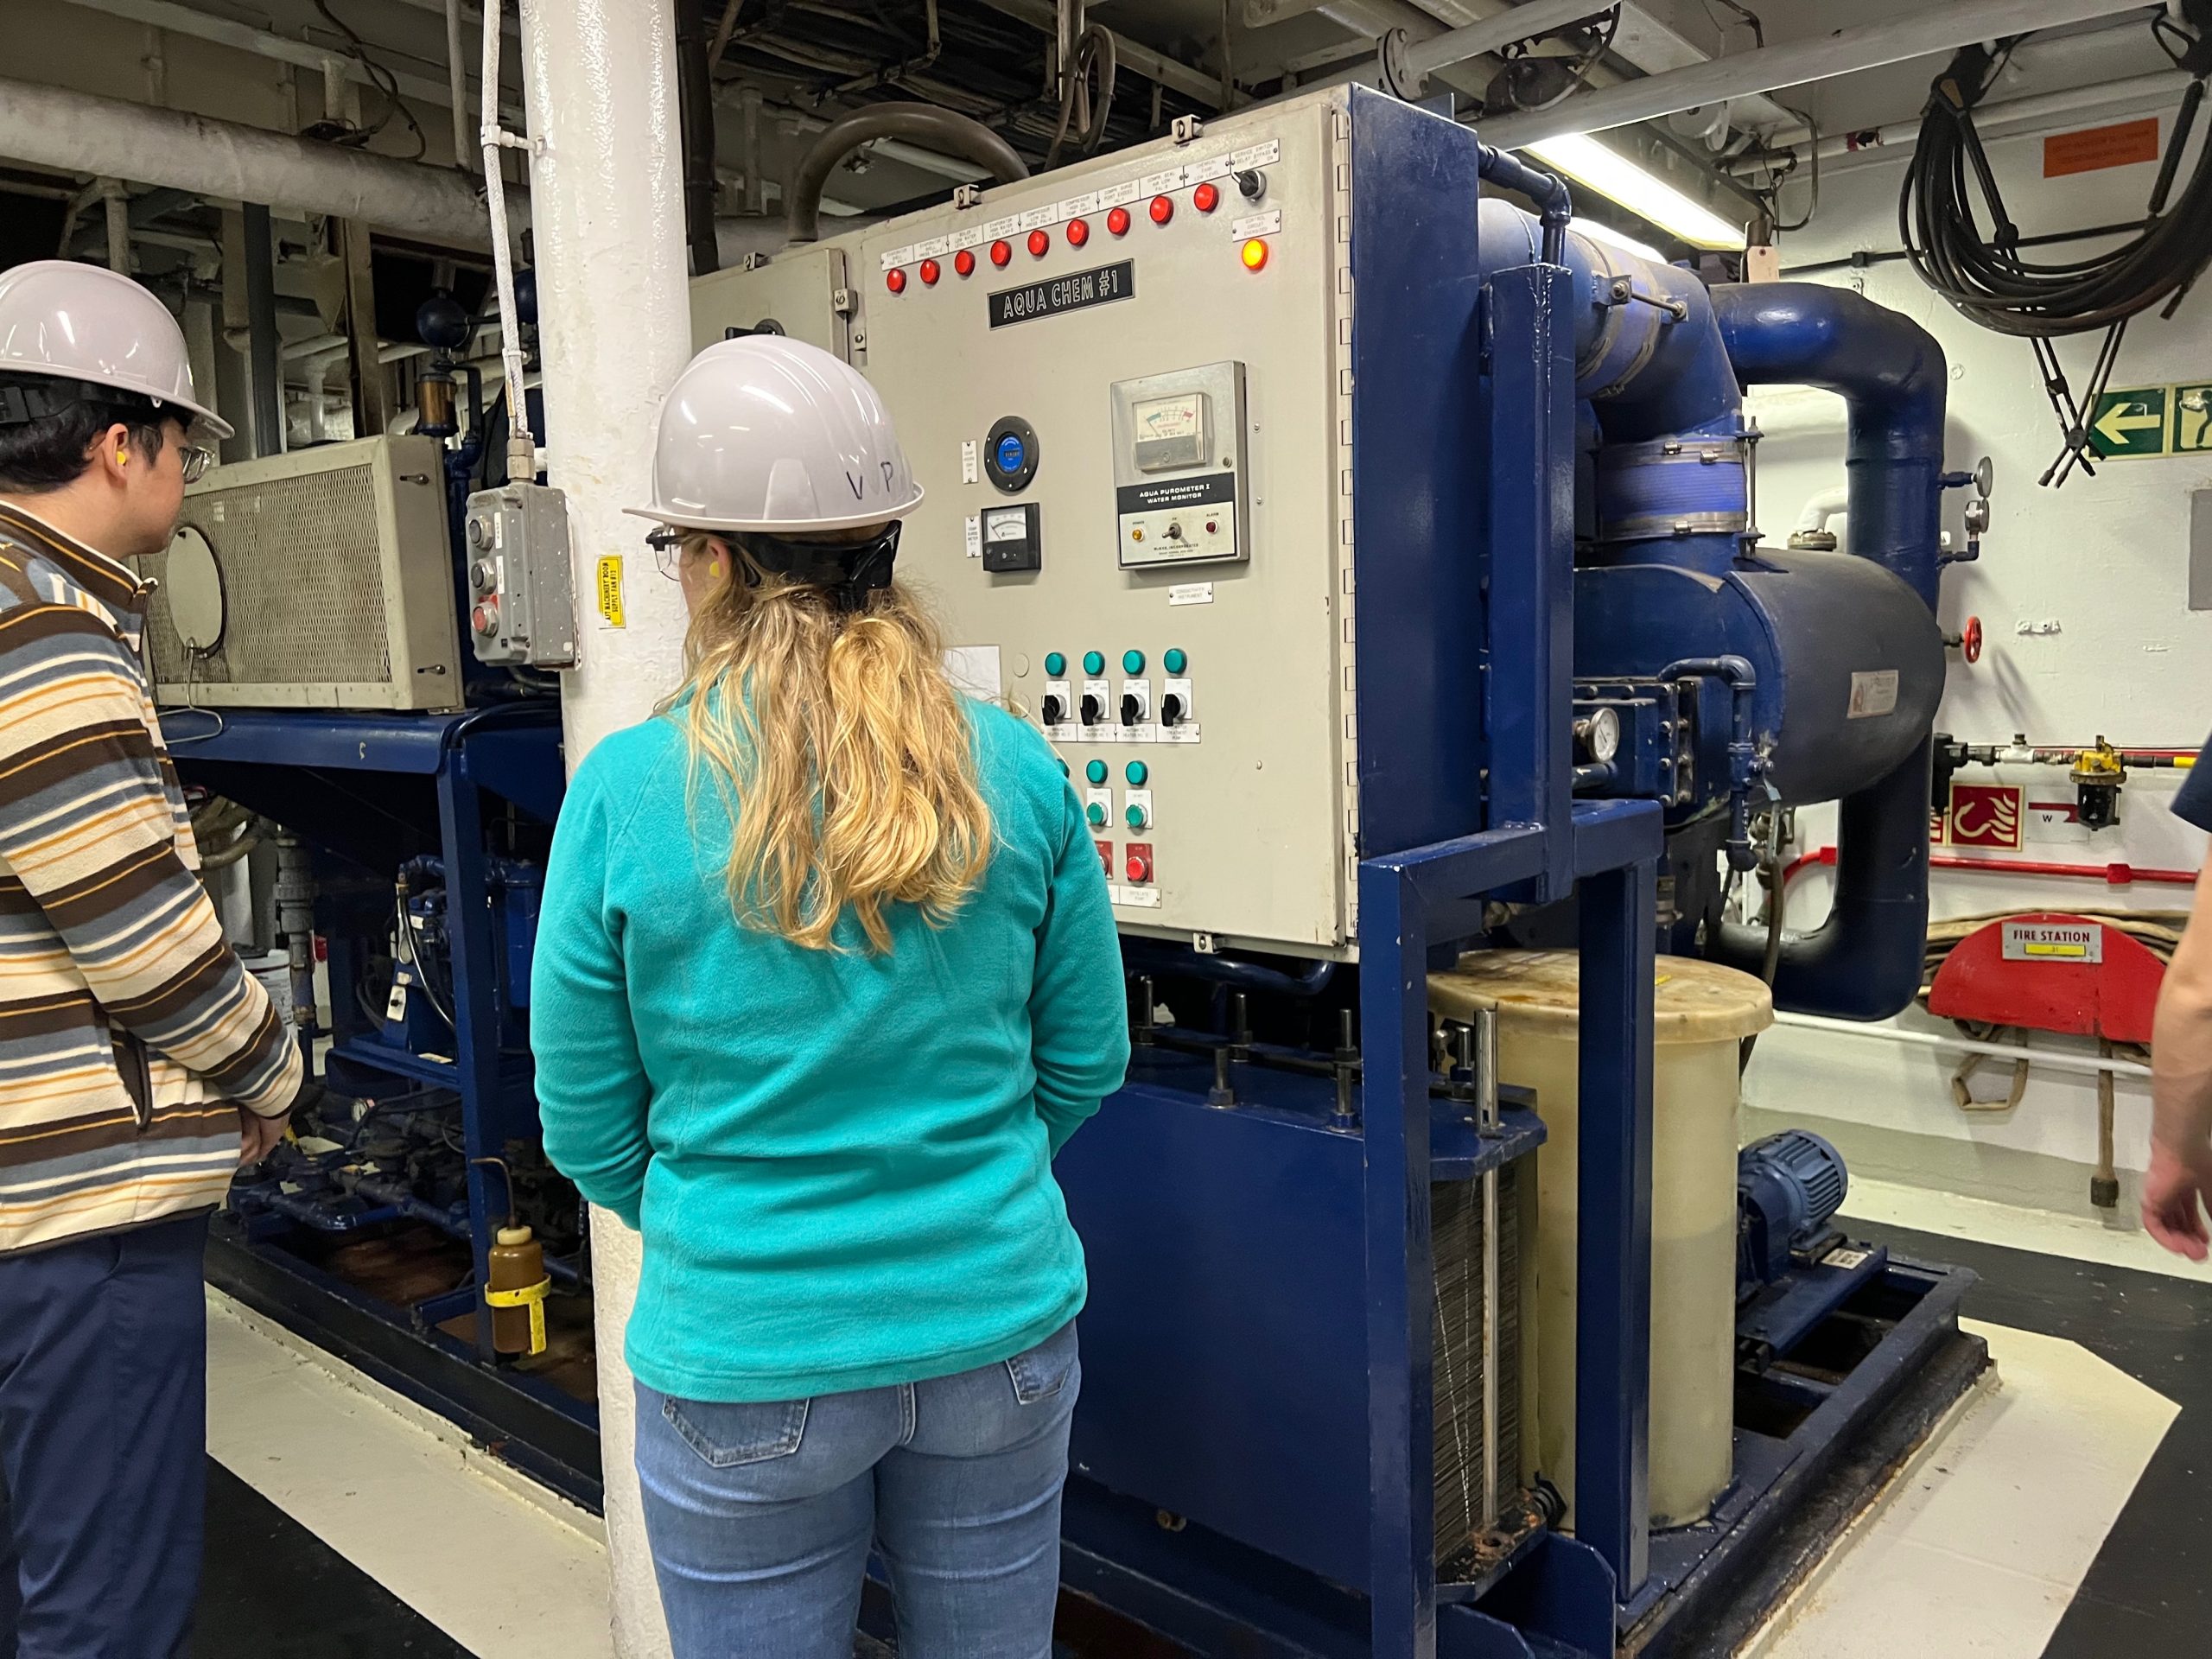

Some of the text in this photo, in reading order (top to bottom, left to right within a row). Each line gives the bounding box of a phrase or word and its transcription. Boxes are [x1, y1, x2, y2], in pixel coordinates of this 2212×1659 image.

[1004, 270, 1118, 319] AQUA CHEM #1
[1140, 489, 1159, 498] AQUA
[1160, 484, 1205, 494] PUROMETER
[1147, 492, 1202, 504] WATER MONITOR
[2043, 814, 2052, 823] W
[2013, 930, 2089, 942] FIRE STATION
